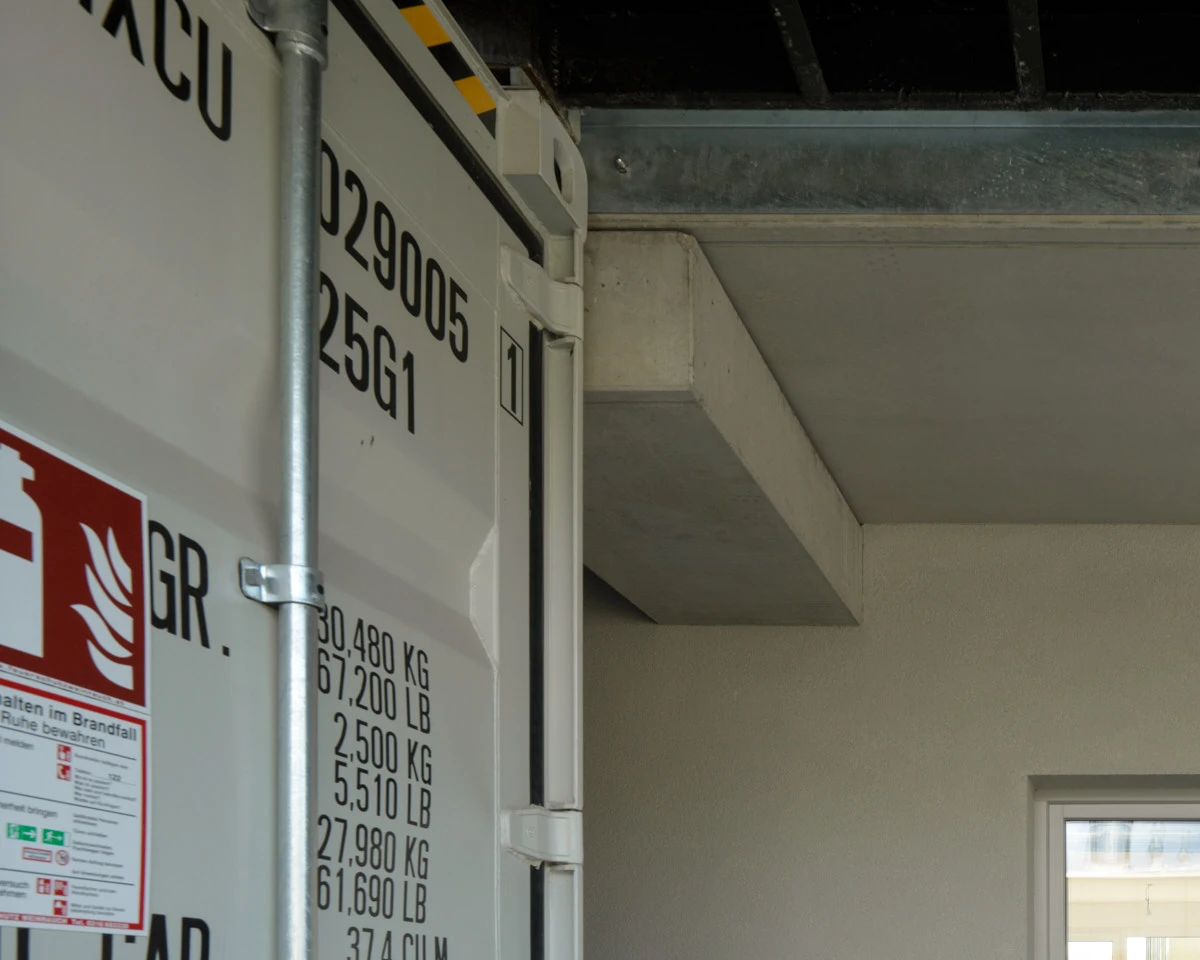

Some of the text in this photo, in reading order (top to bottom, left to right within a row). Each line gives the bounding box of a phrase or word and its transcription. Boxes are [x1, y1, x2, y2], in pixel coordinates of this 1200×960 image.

[320, 138, 469, 363] 029005
[507, 343, 516, 414] 1
[319, 271, 415, 434] 25G1
[318, 604, 429, 691] 30,480 KG
[0, 694, 136, 741] alten im Brandfall
[318, 648, 430, 734] 67,200 LB
[1, 710, 106, 749] Ruhe bewahren
[334, 712, 432, 785] 2,500 KG
[334, 760, 431, 829] 5,510 LB
[317, 814, 429, 880] 27,980 KG
[317, 865, 426, 924] 61,690 LB
